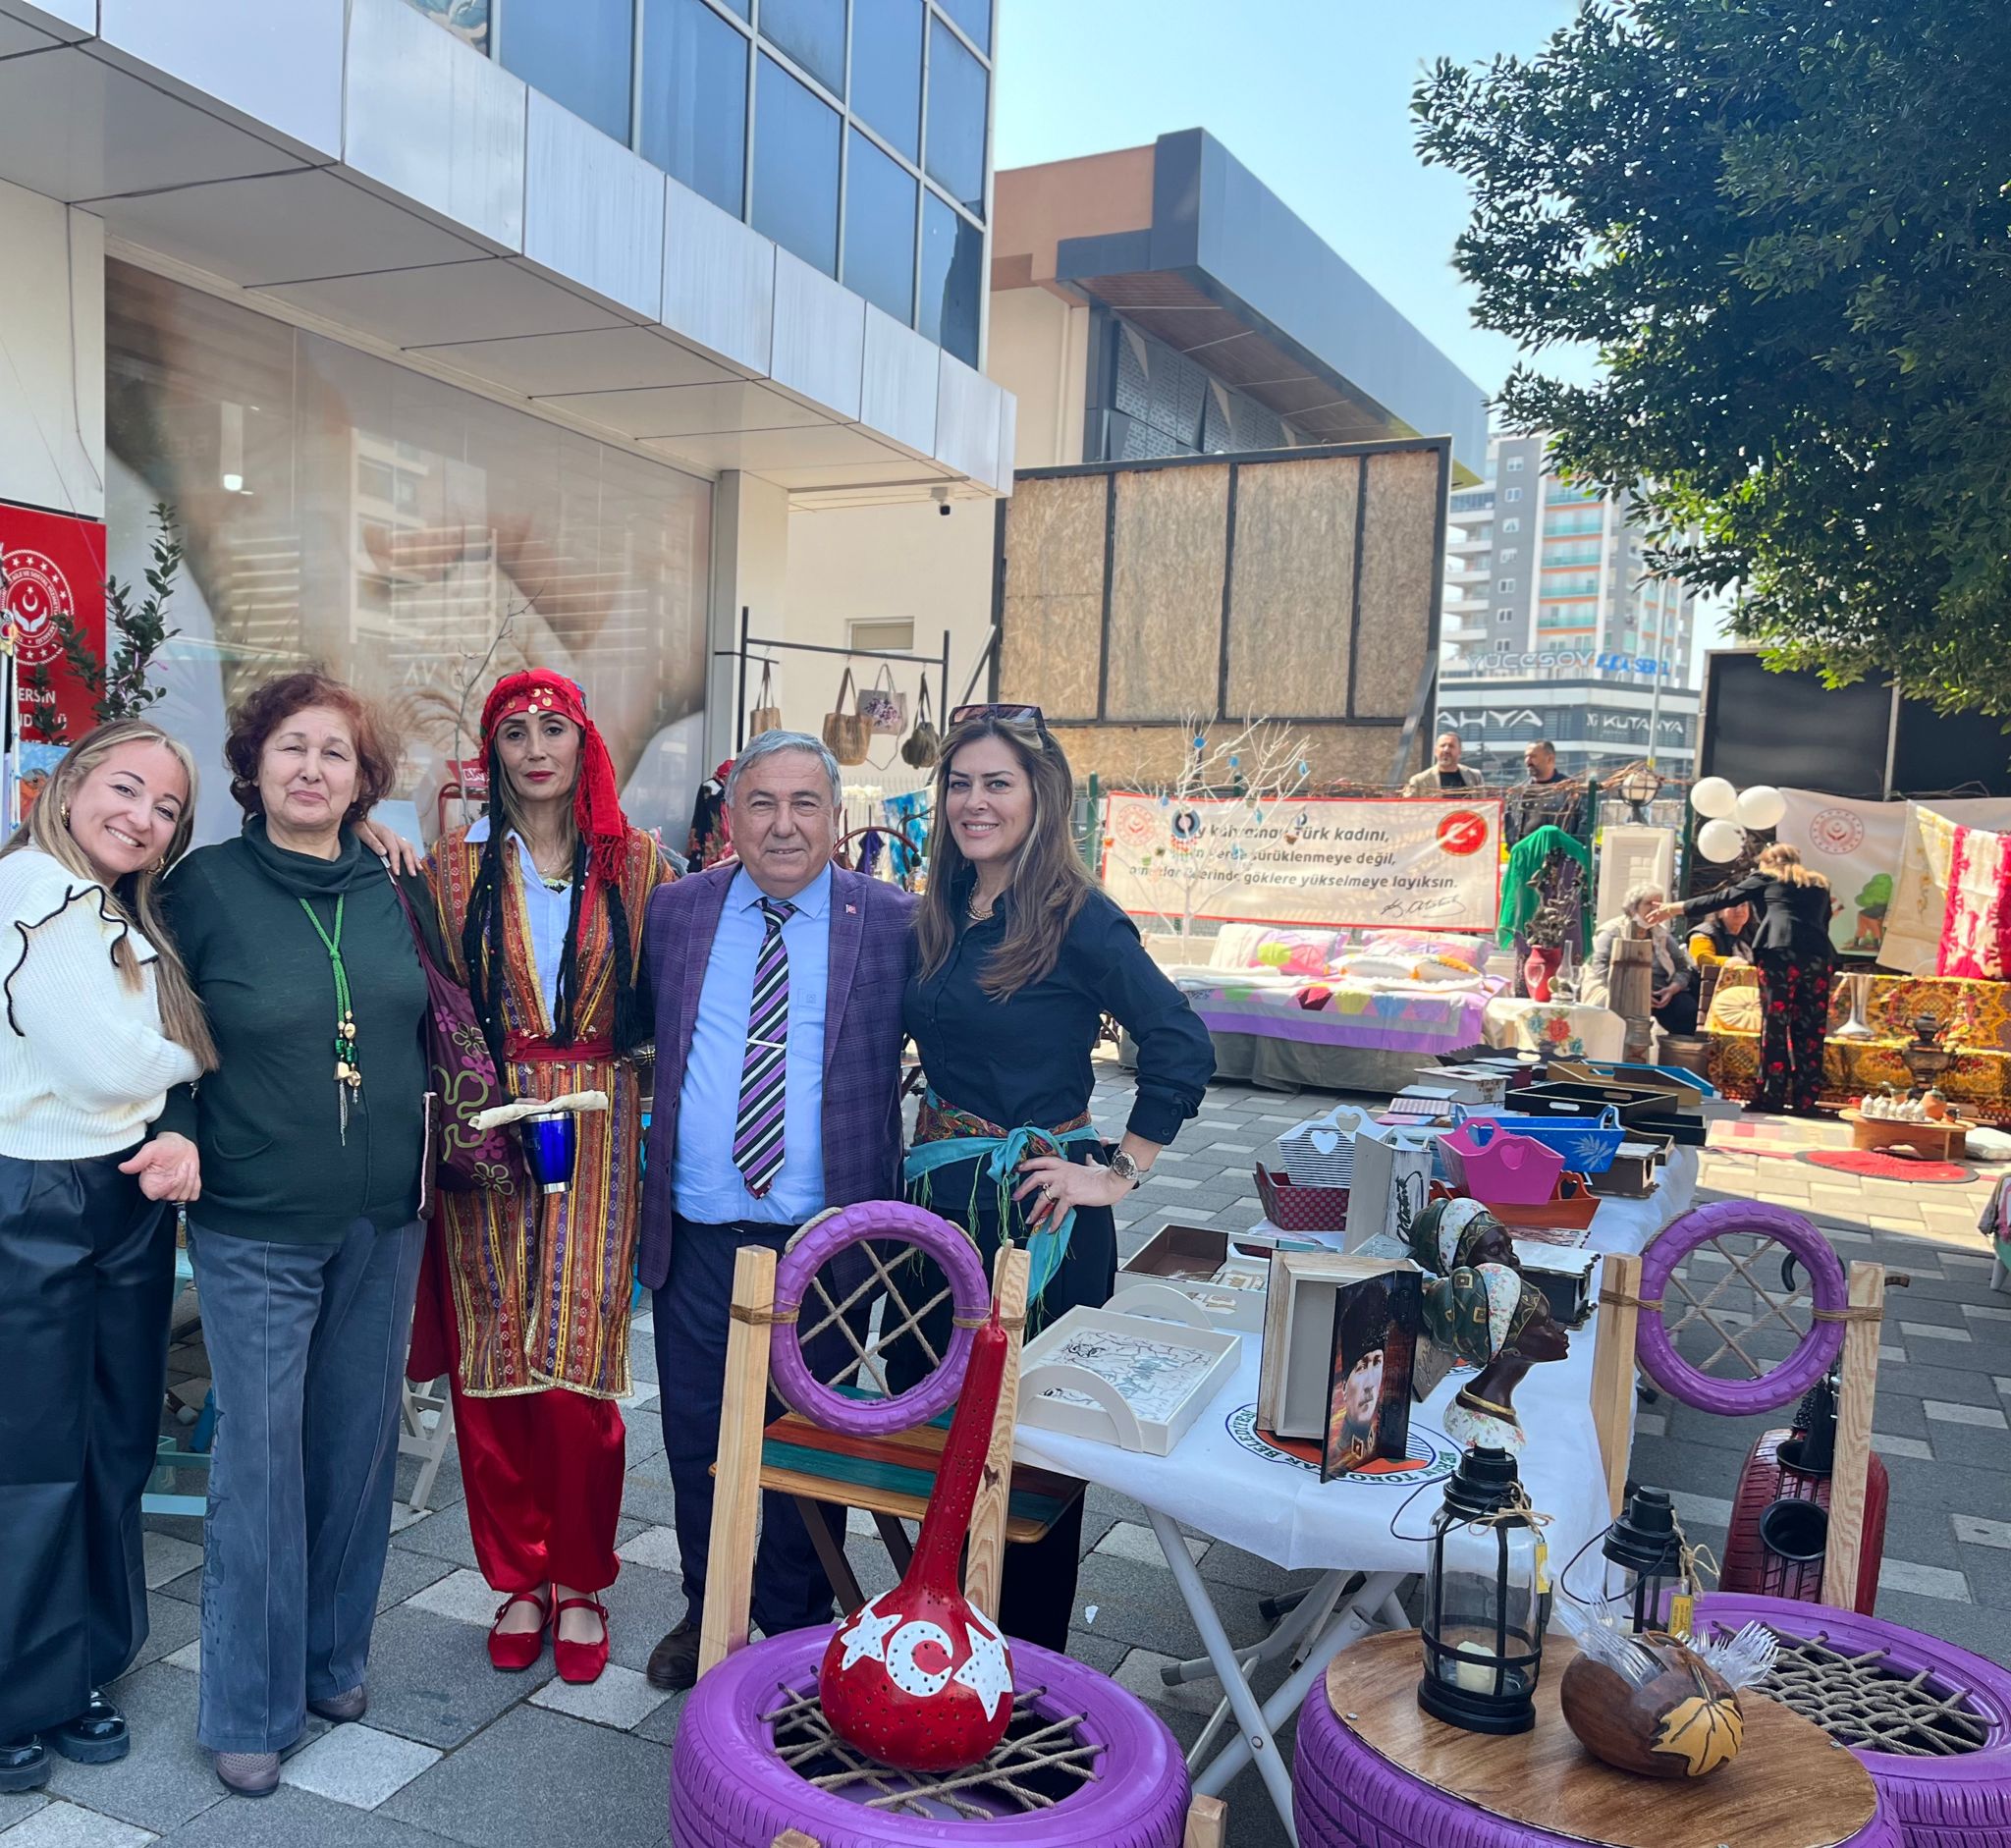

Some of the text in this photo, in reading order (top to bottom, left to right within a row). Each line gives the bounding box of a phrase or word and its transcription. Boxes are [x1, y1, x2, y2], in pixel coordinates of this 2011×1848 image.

[19, 686, 56, 704] ERSİN
[1437, 709, 1544, 729] AHYA
[1333, 827, 1390, 842] kadını,
[1253, 849, 1352, 866] ürüklenmeye
[1356, 852, 1396, 867] değil,
[1244, 871, 1297, 886] göklere
[1301, 875, 1388, 890] yükselmeye
[1391, 876, 1458, 890] layıksın.
